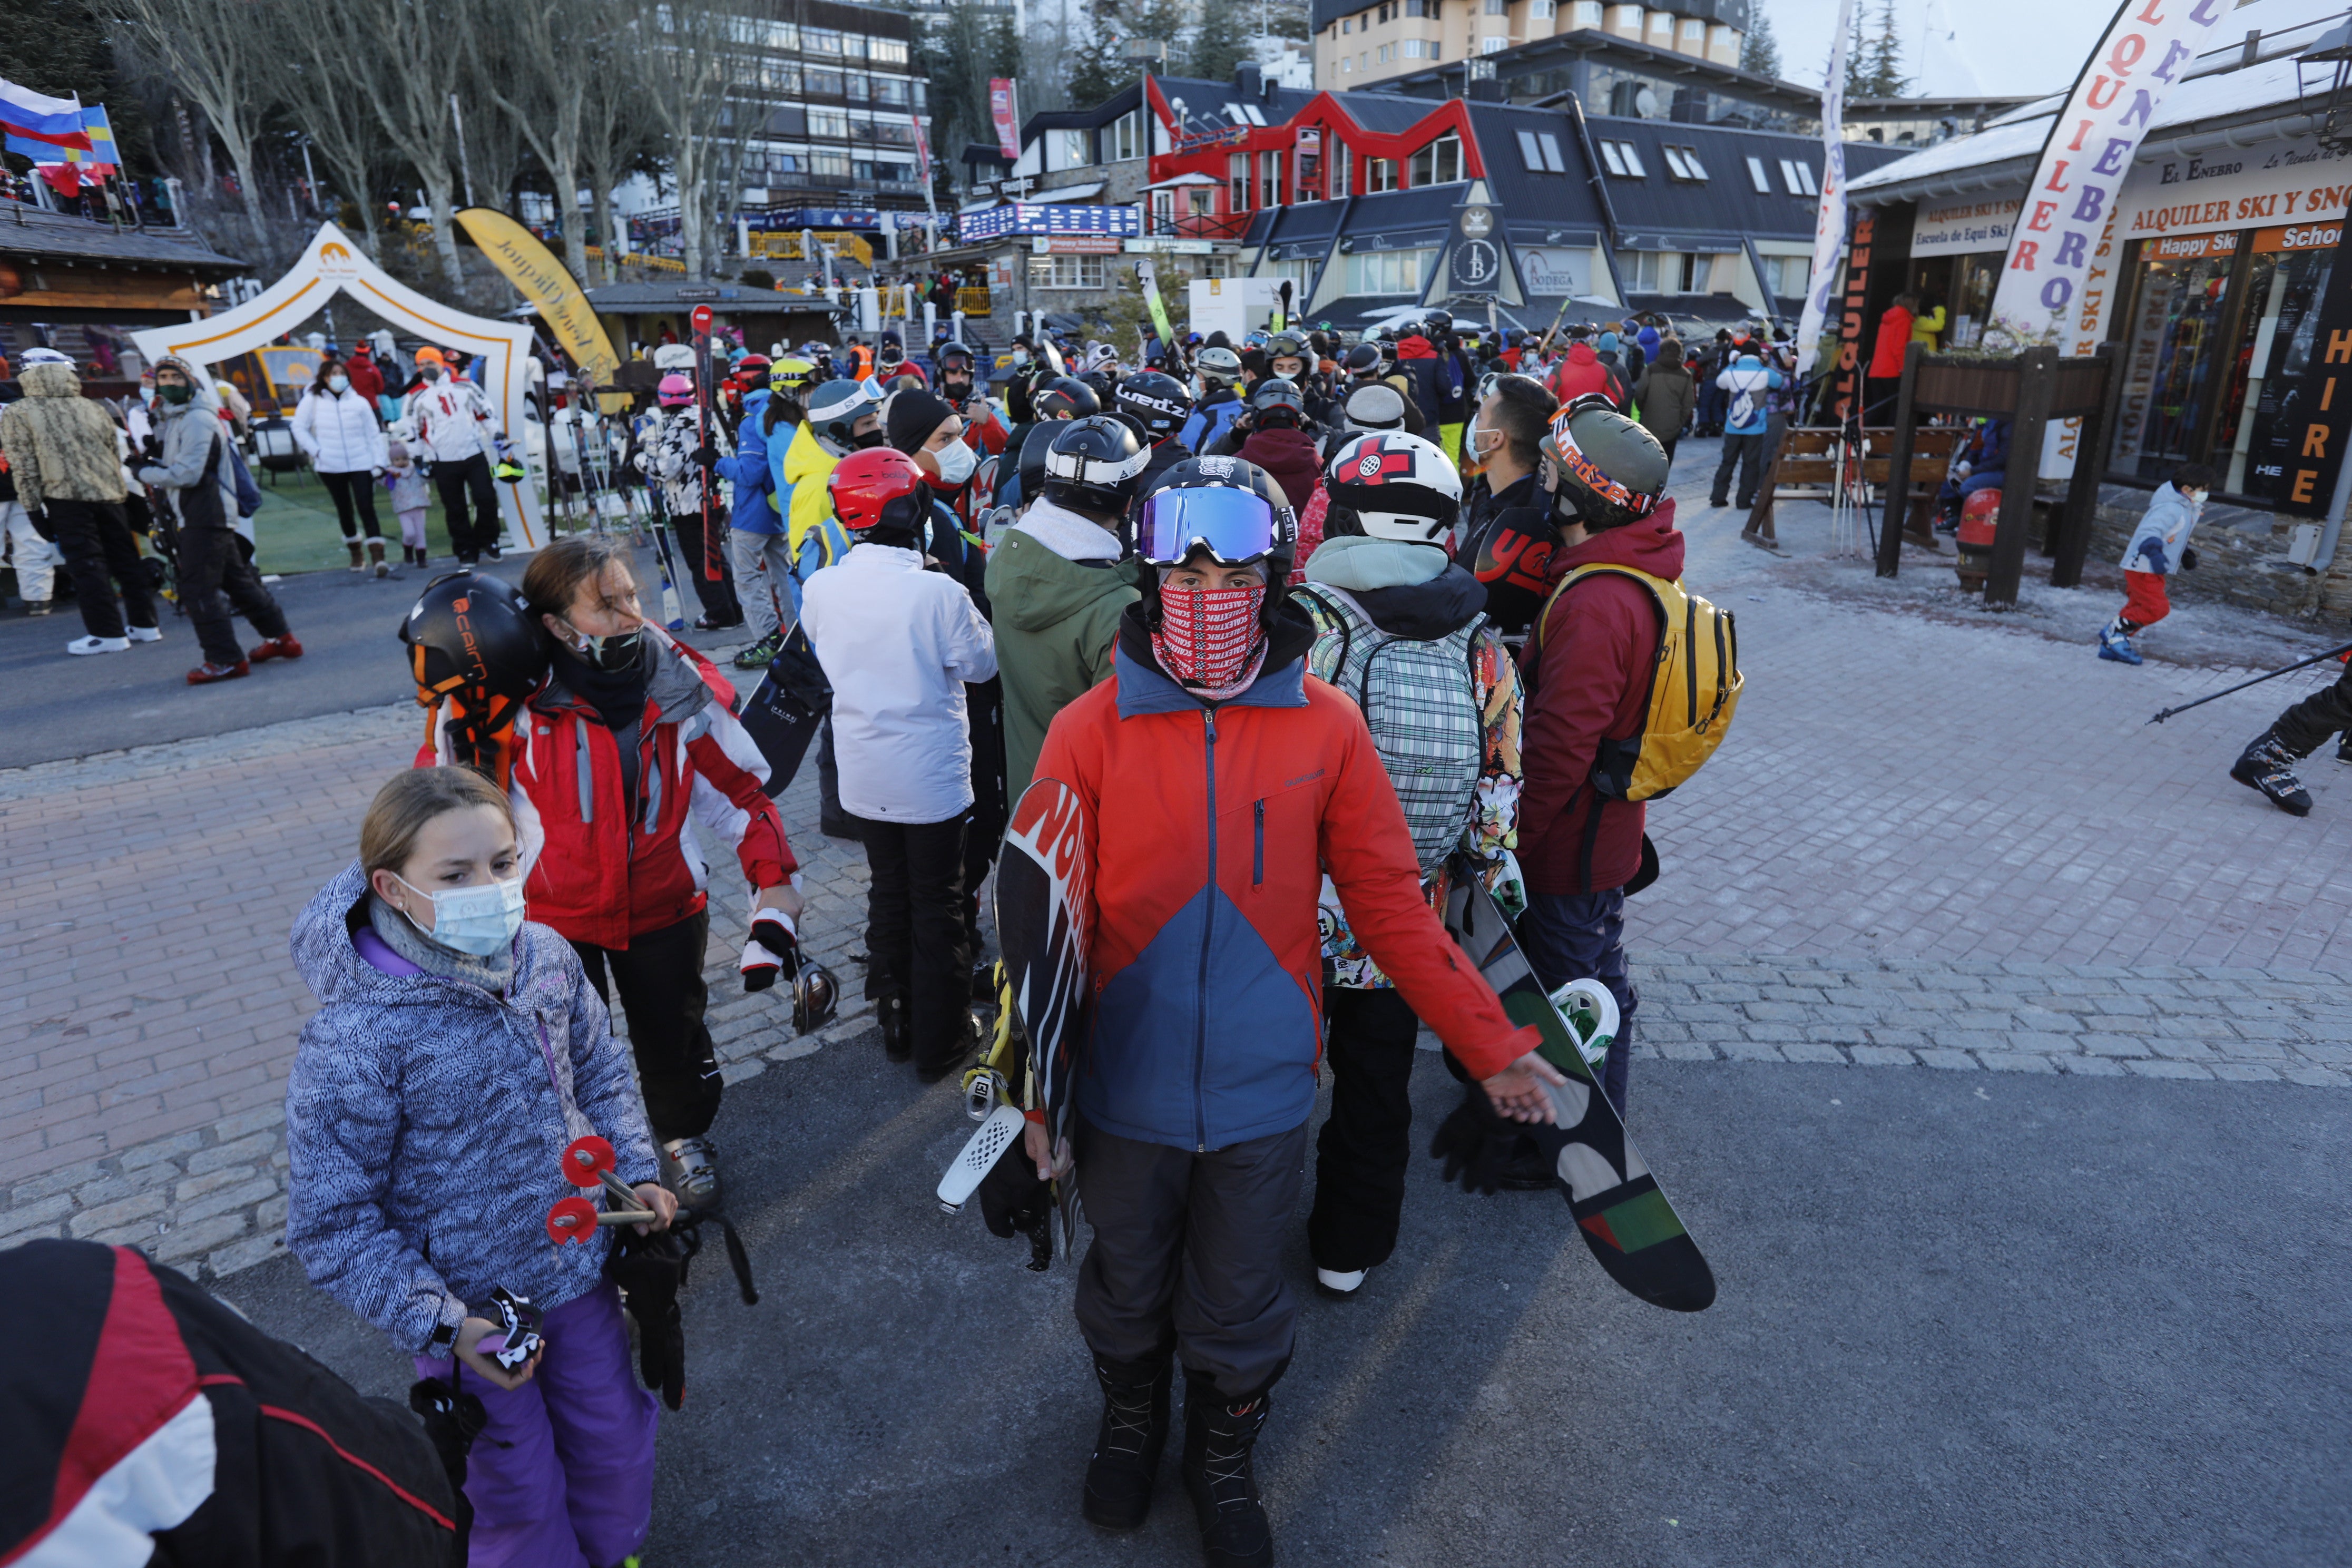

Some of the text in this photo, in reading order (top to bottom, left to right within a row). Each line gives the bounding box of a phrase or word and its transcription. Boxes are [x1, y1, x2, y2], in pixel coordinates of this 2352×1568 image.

[1927, 205, 1972, 223] ALQUILER
[1975, 202, 1992, 217] SKI
[2131, 200, 2230, 232] ALQUILER
[2236, 194, 2278, 220] SKI
[2284, 191, 2303, 215] Y
[1915, 223, 2008, 246] Escuela de Equi Ski
[2159, 232, 2238, 257] Happy Ski
[2089, 266, 2106, 282] Y
[1834, 217, 1875, 421] ALQUILER
[2080, 289, 2103, 332] SKI
[2290, 329, 2352, 503] HIRE
[1204, 590, 1247, 601] SCALEXTRIC
[1204, 600, 1250, 611] SCALEXTRIC
[1206, 606, 1247, 621] SCALEXTRIC
[1206, 614, 1248, 631] SCALEXTRIC
[1206, 624, 1247, 640] SCALEXTRIC
[1206, 633, 1247, 650] SCALEXTRIC
[1206, 642, 1247, 660] SCALEXTRIC
[1285, 768, 1325, 787] QUIKSILVER
